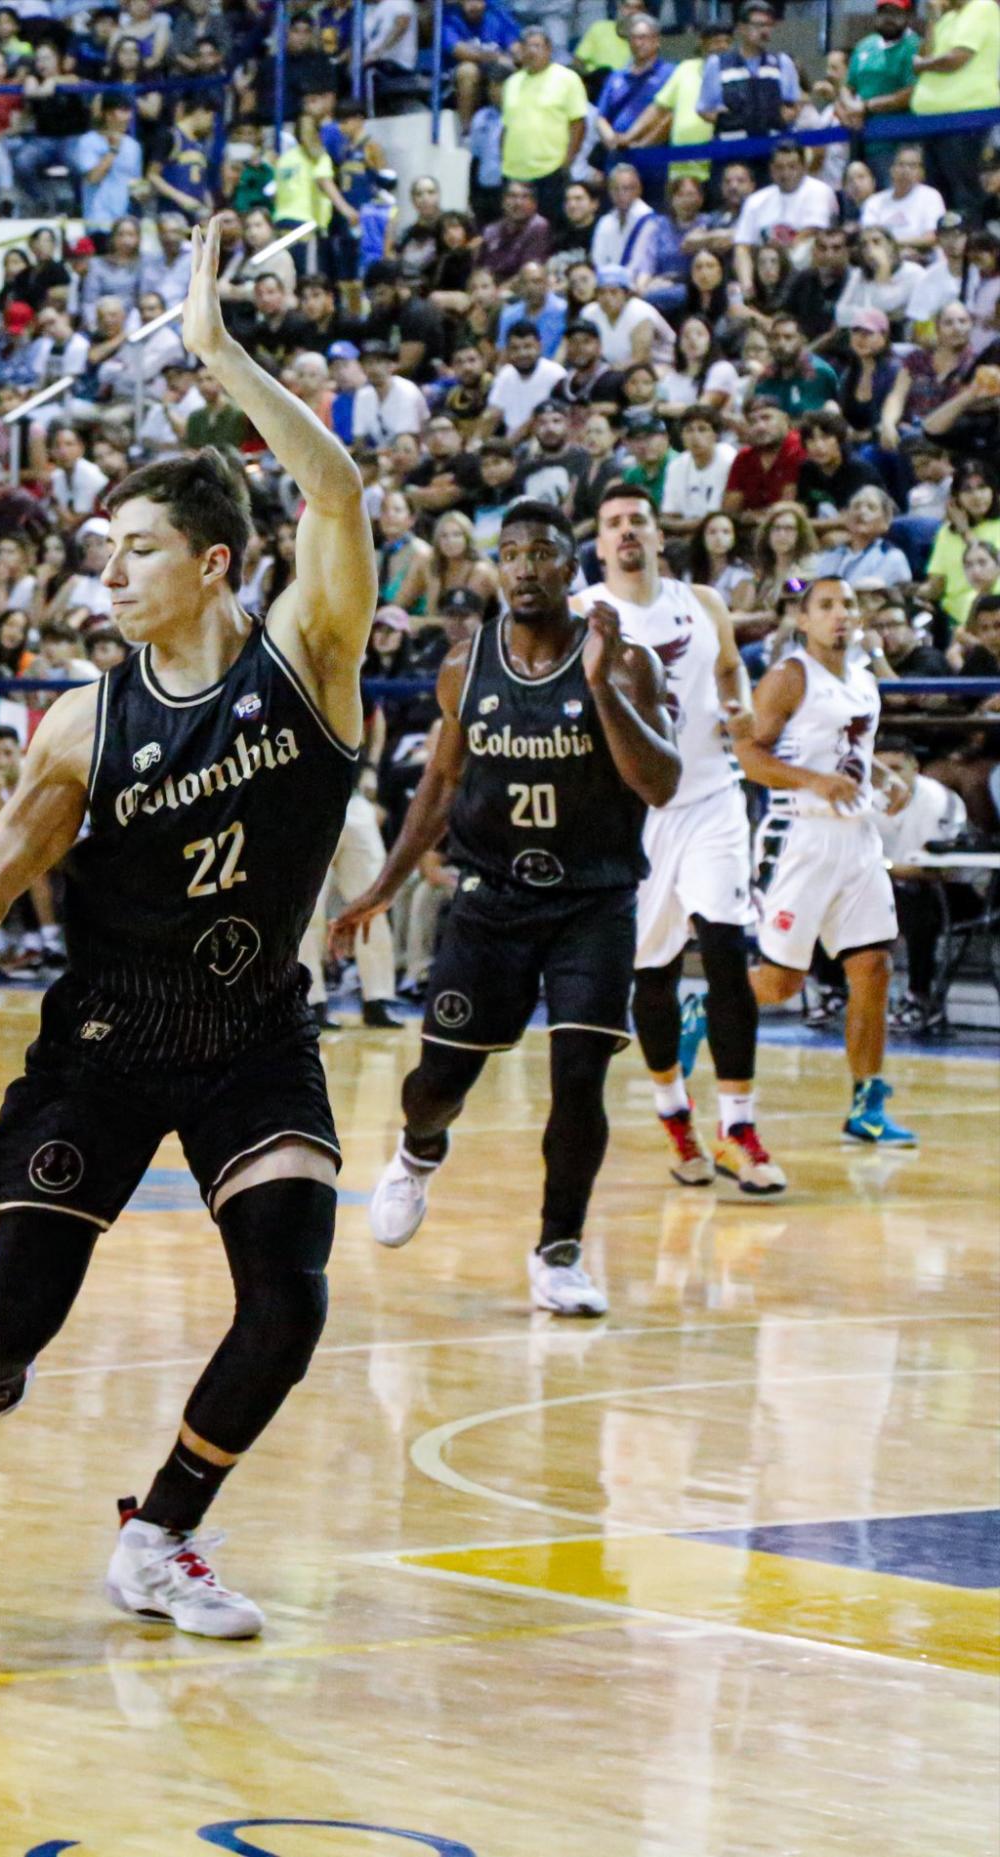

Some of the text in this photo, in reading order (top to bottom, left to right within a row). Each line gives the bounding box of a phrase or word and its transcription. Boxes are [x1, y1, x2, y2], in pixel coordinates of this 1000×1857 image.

[468, 721, 593, 759] Colombia
[115, 724, 300, 827] Colombia
[508, 783, 557, 828] 20
[183, 821, 248, 898] 22
